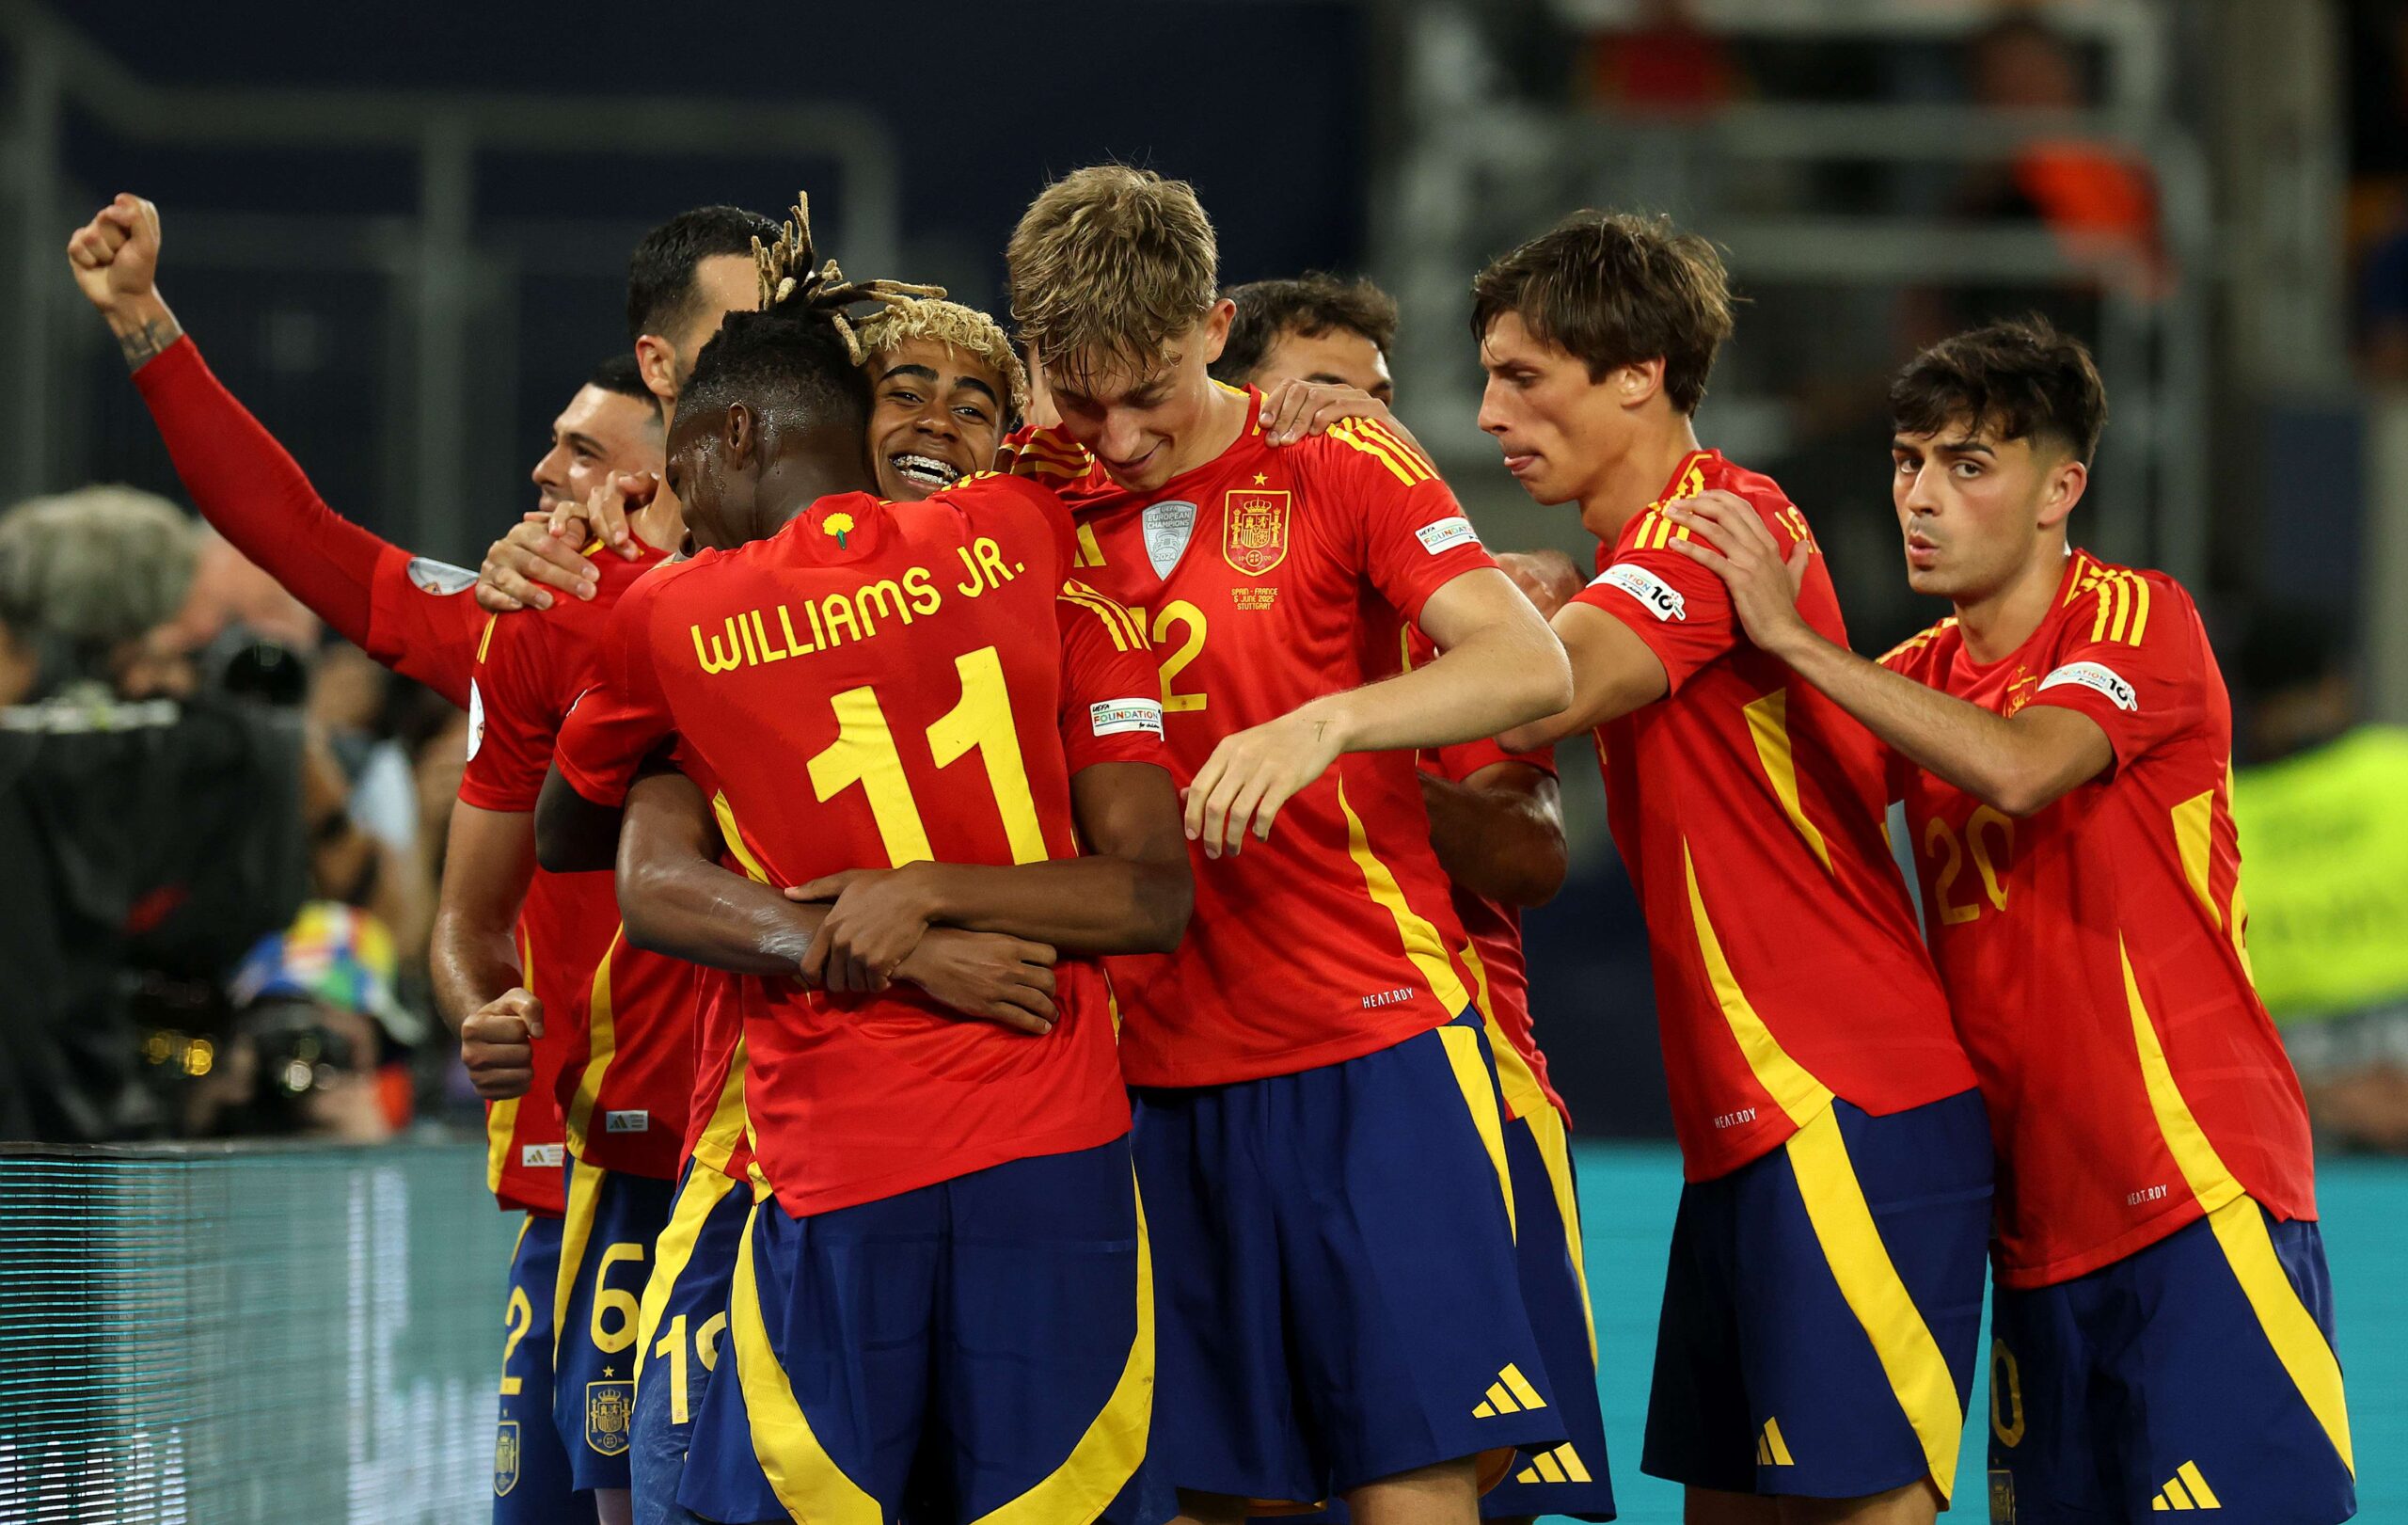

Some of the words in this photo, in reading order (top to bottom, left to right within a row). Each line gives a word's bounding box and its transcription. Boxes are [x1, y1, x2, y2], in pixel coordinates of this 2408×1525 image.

[1147, 520, 1190, 529] CHAMPIONS
[1148, 512, 1191, 521] EUROPEAN
[1418, 527, 1435, 537] UEFA
[1155, 552, 1176, 562] 2024
[690, 566, 942, 675] WILLIAMS
[957, 537, 1025, 597] JR.
[1237, 602, 1272, 611] STUTTGART
[1129, 599, 1208, 712] 2
[1092, 704, 1110, 712] UEFA
[1093, 710, 1159, 724] FOUNDATION
[806, 645, 1049, 869] 11
[1925, 803, 2016, 926] 20
[1362, 988, 1414, 1009] HEAT.RDY
[1714, 1107, 1756, 1129] HEAT.RDY
[2127, 1184, 2167, 1205] HEAT.RDY
[591, 1243, 644, 1354] 6
[499, 1285, 532, 1395] 2
